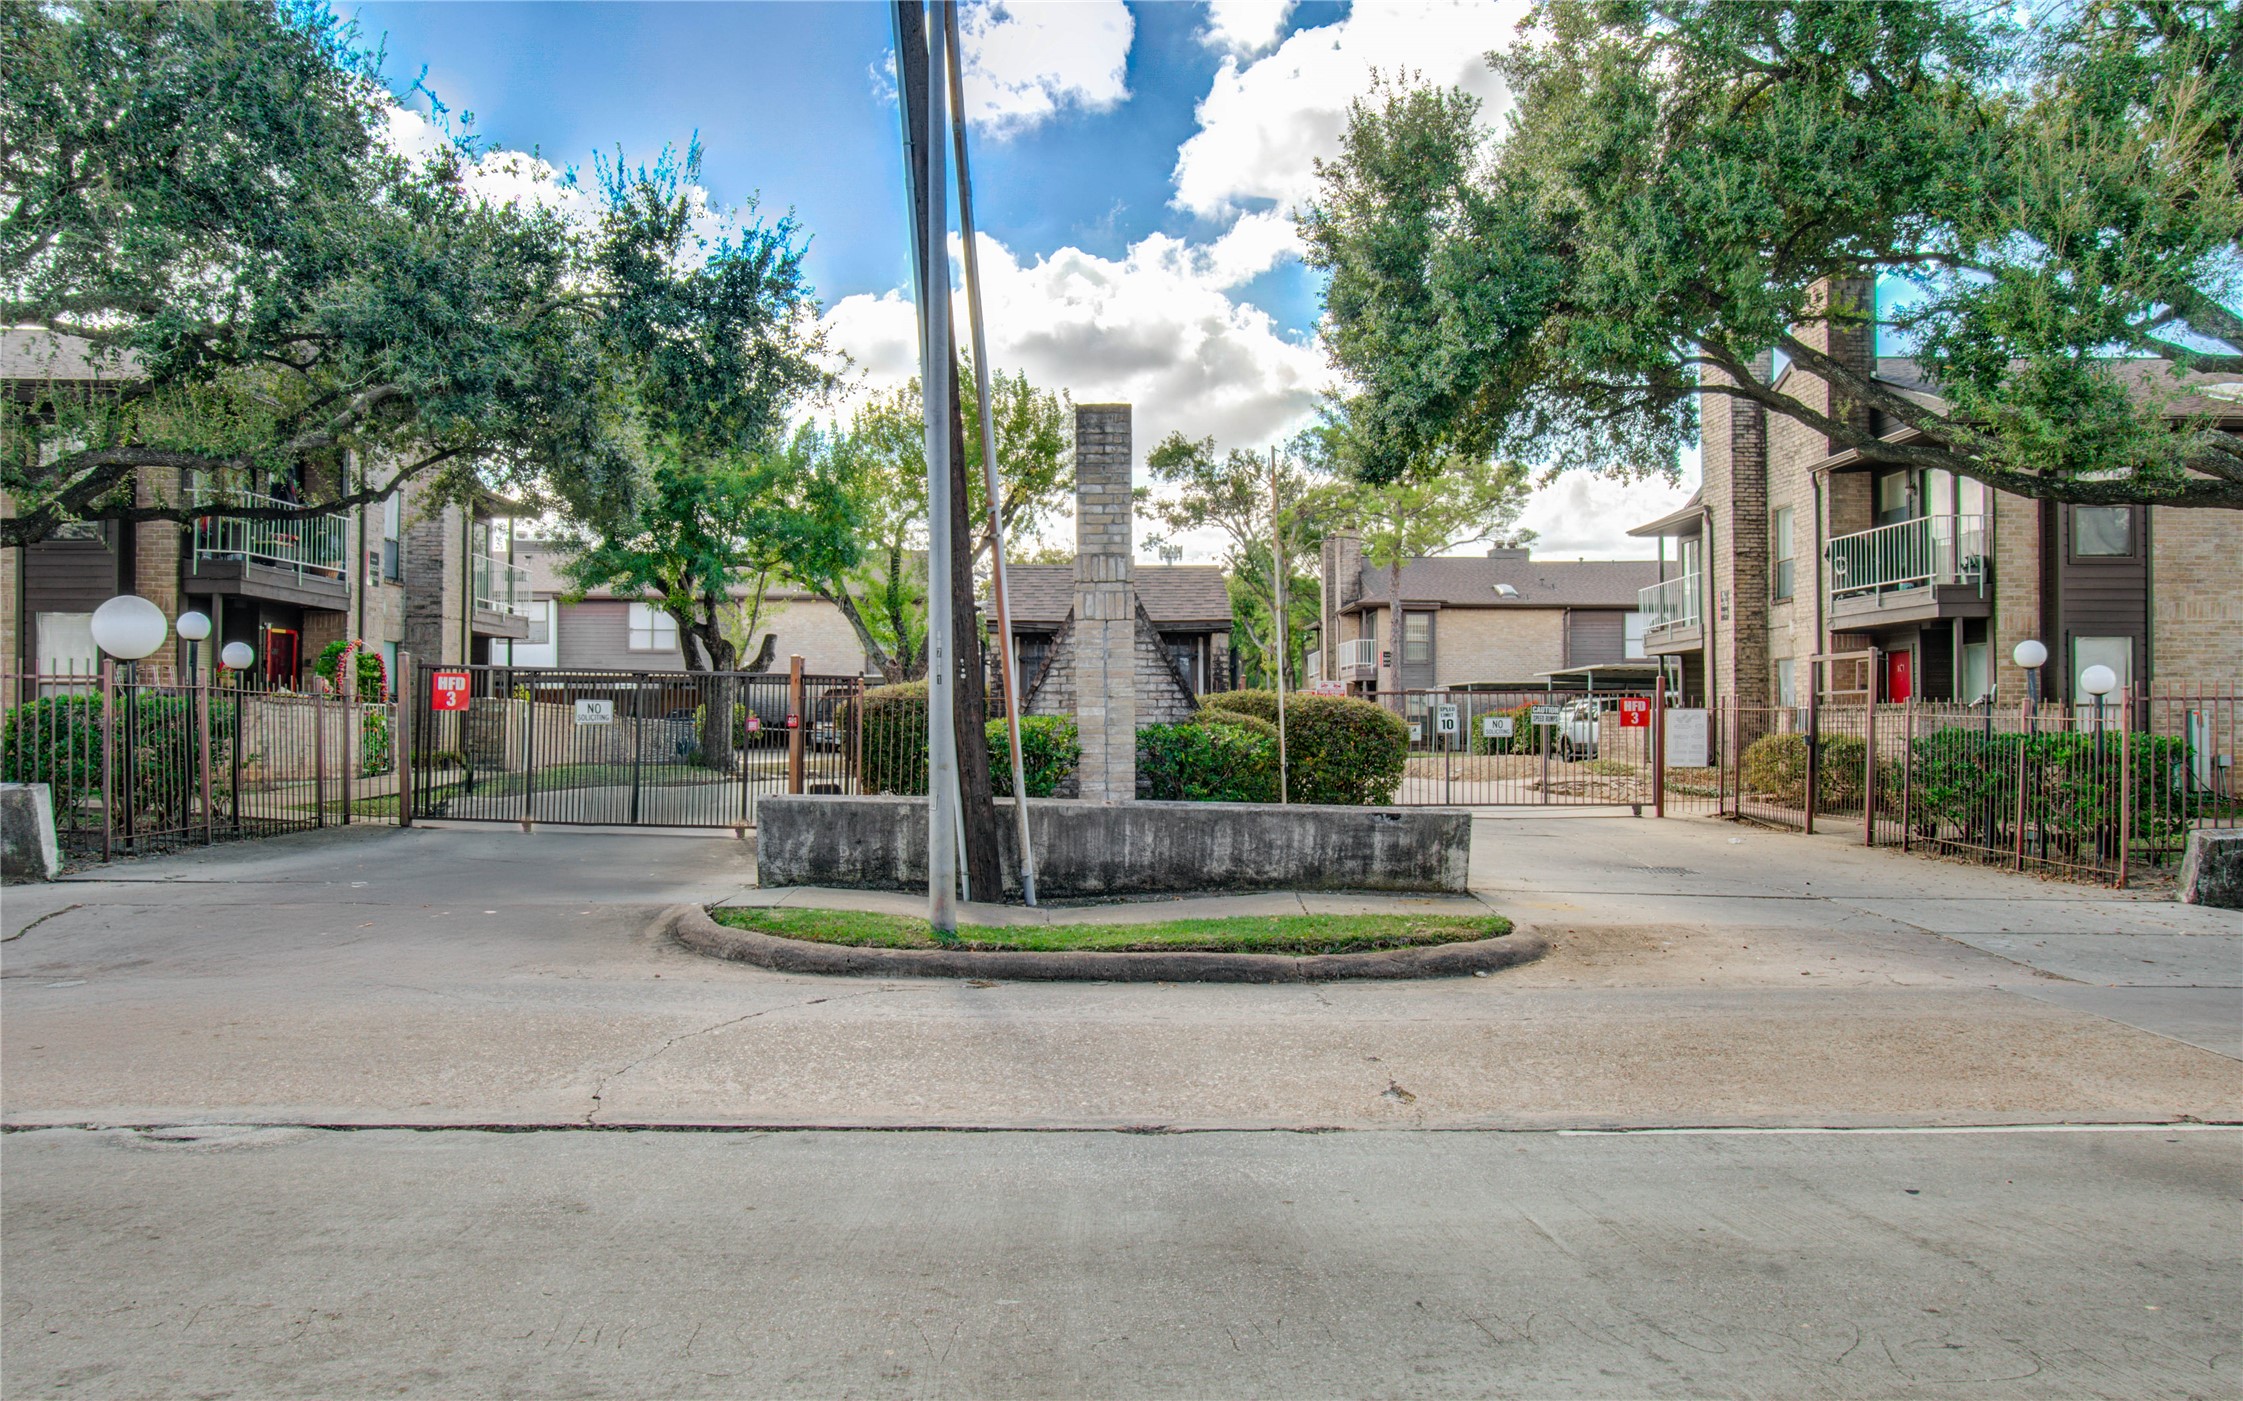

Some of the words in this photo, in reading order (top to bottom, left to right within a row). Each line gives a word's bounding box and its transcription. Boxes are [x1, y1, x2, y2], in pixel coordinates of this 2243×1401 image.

[437, 676, 466, 691] HFD
[446, 691, 456, 707] 3
[587, 703, 602, 714] NO
[1532, 706, 1559, 714] CAUTION
[1623, 700, 1646, 712] HFD
[1630, 711, 1639, 725] 3
[1442, 719, 1454, 730] 10
[1492, 719, 1504, 729] NO
